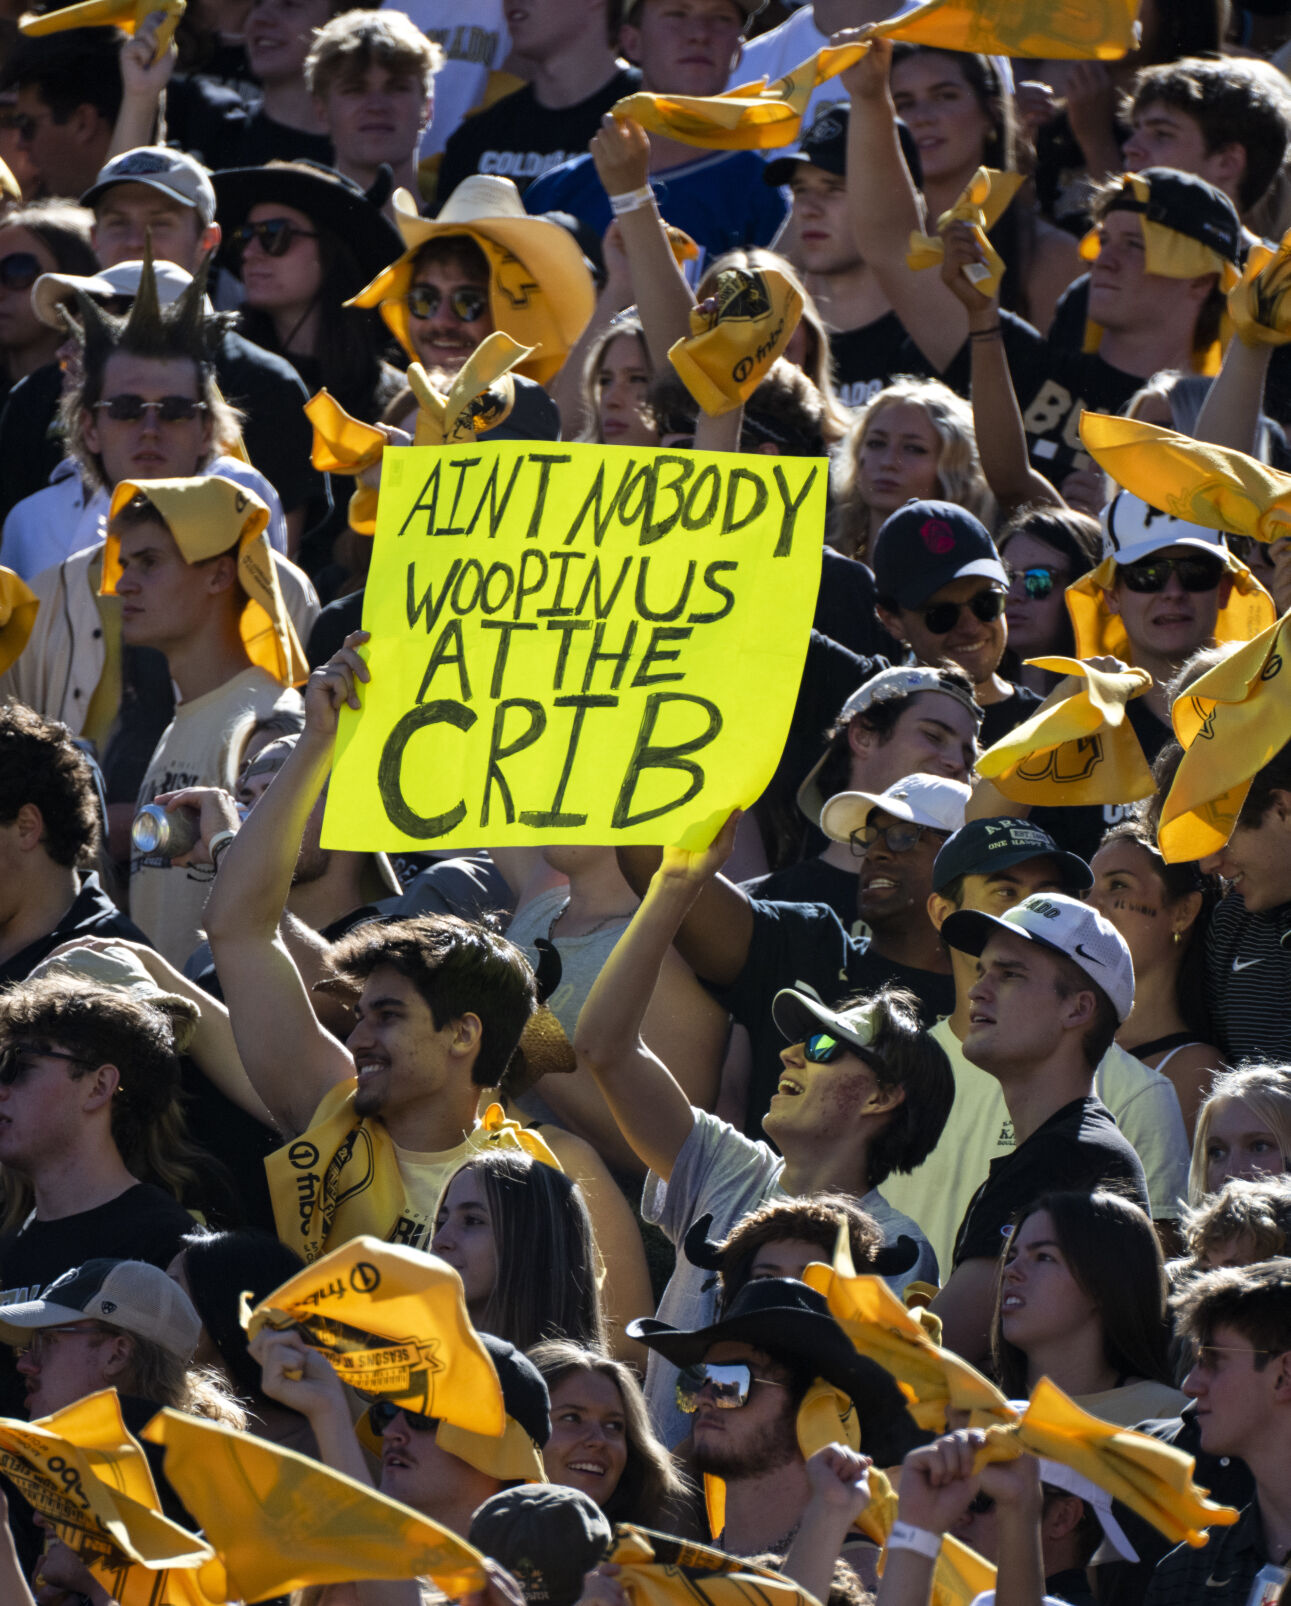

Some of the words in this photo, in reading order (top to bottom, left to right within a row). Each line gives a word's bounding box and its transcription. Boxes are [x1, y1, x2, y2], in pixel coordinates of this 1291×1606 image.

[398, 453, 572, 539] AINT
[563, 454, 818, 558] NOBODY
[415, 618, 538, 705] AT
[546, 619, 694, 692] THE
[377, 692, 723, 840] CRIB
